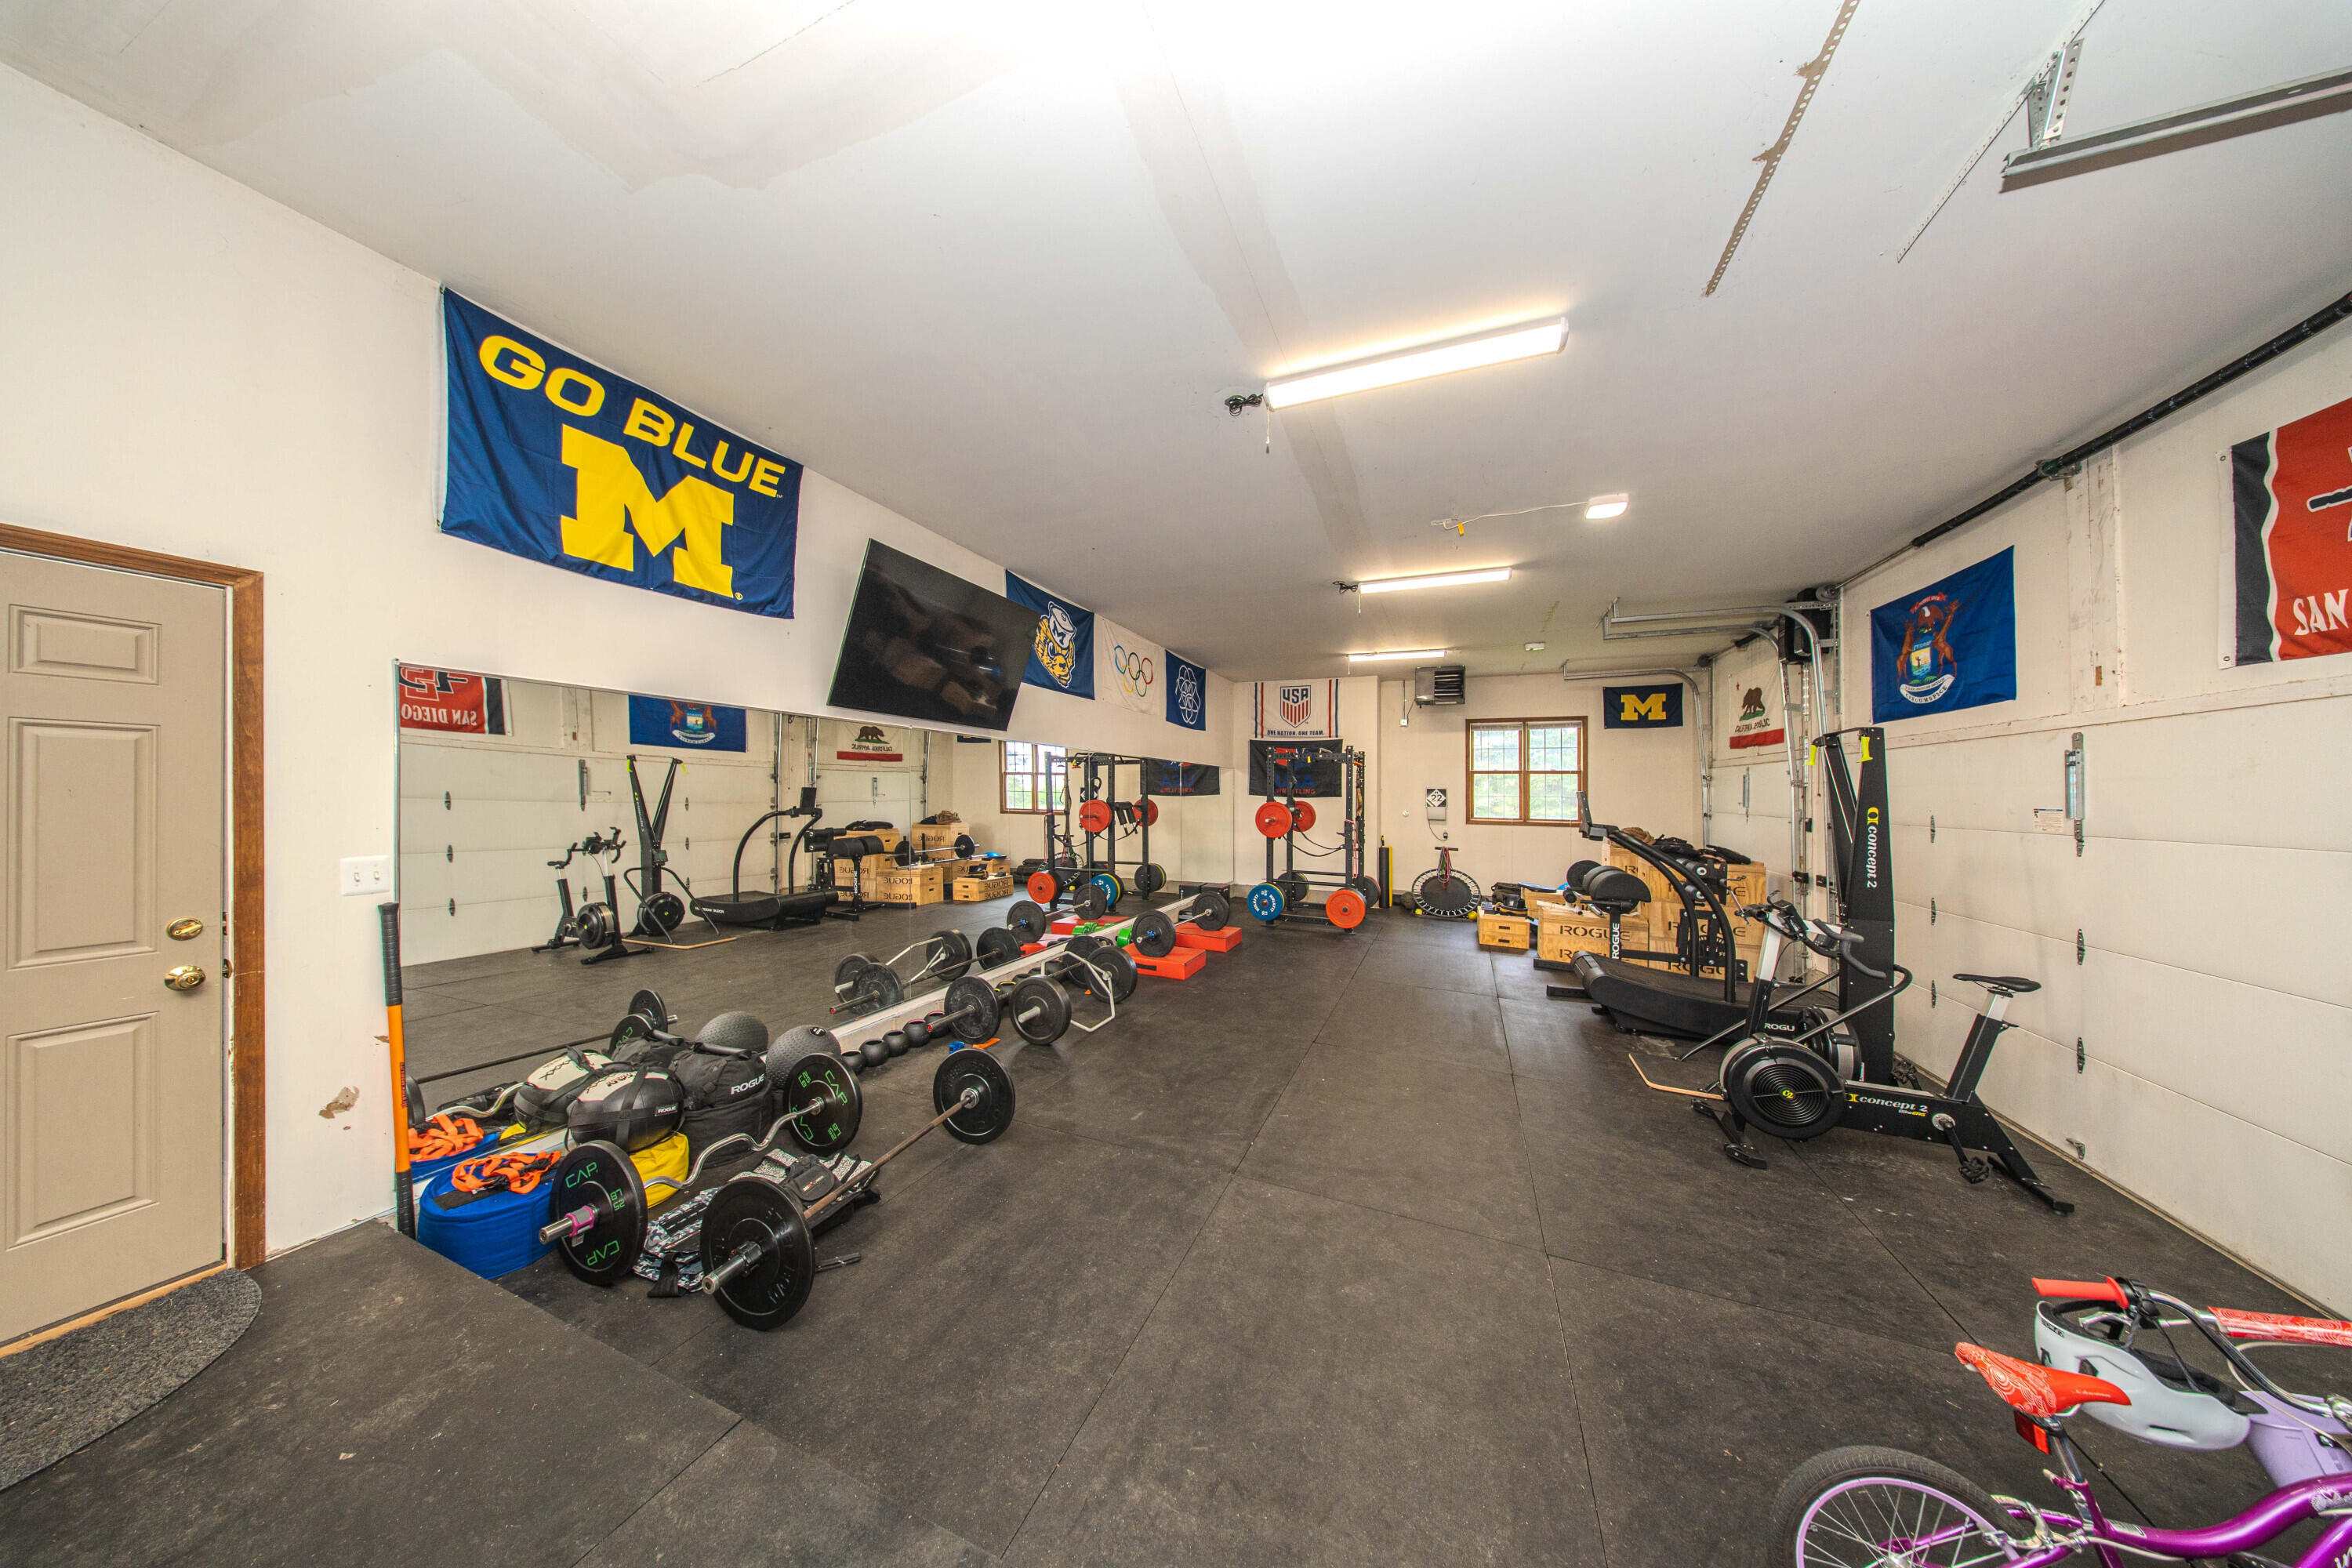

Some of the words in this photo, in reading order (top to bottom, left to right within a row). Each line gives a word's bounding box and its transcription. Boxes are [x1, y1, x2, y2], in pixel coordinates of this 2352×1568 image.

[479, 335, 605, 417] GO
[623, 397, 786, 498] BLUE
[560, 423, 735, 598] M
[2293, 589, 2349, 636] SAN
[1283, 688, 1308, 704] USA
[1621, 693, 1667, 720] M
[1867, 826, 1878, 879] concept
[1866, 880, 1878, 888] 2
[1611, 922, 1620, 960] ROGUE
[1764, 1022, 1795, 1032] ROGU
[731, 1073, 765, 1094] ROGUE
[825, 1070, 848, 1104] CAP
[1860, 1096, 1916, 1110] concept
[565, 1162, 597, 1188] CAP
[613, 1200, 626, 1211] 25
[587, 1240, 620, 1265] CAP
